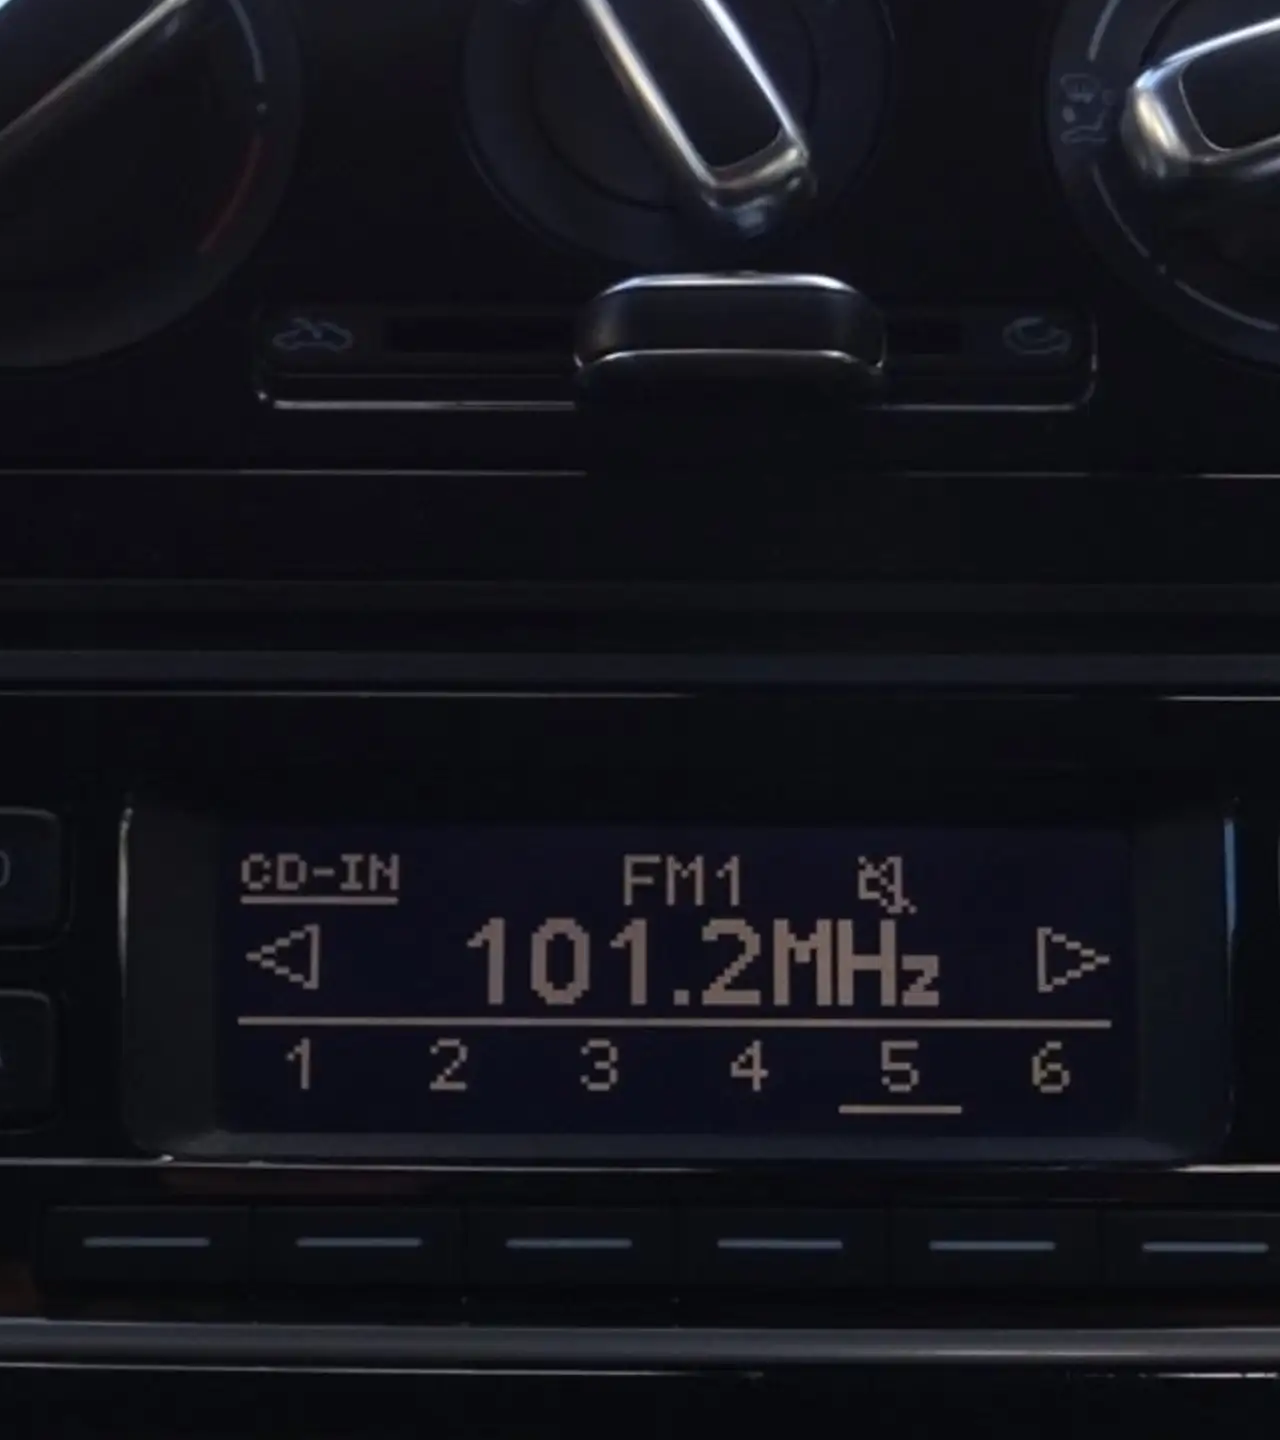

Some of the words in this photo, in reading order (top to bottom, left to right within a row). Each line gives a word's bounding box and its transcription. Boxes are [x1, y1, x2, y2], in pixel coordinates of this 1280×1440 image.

[240, 853, 400, 891] CD-IN
[623, 854, 740, 906] FM1
[466, 917, 940, 1007] 101.2MHz
[286, 1037, 310, 1090] 1
[429, 1038, 468, 1091] 2
[580, 1039, 618, 1091] 3
[730, 1039, 769, 1092] 4
[881, 1040, 919, 1093] 5
[1031, 1040, 1071, 1094] 6
